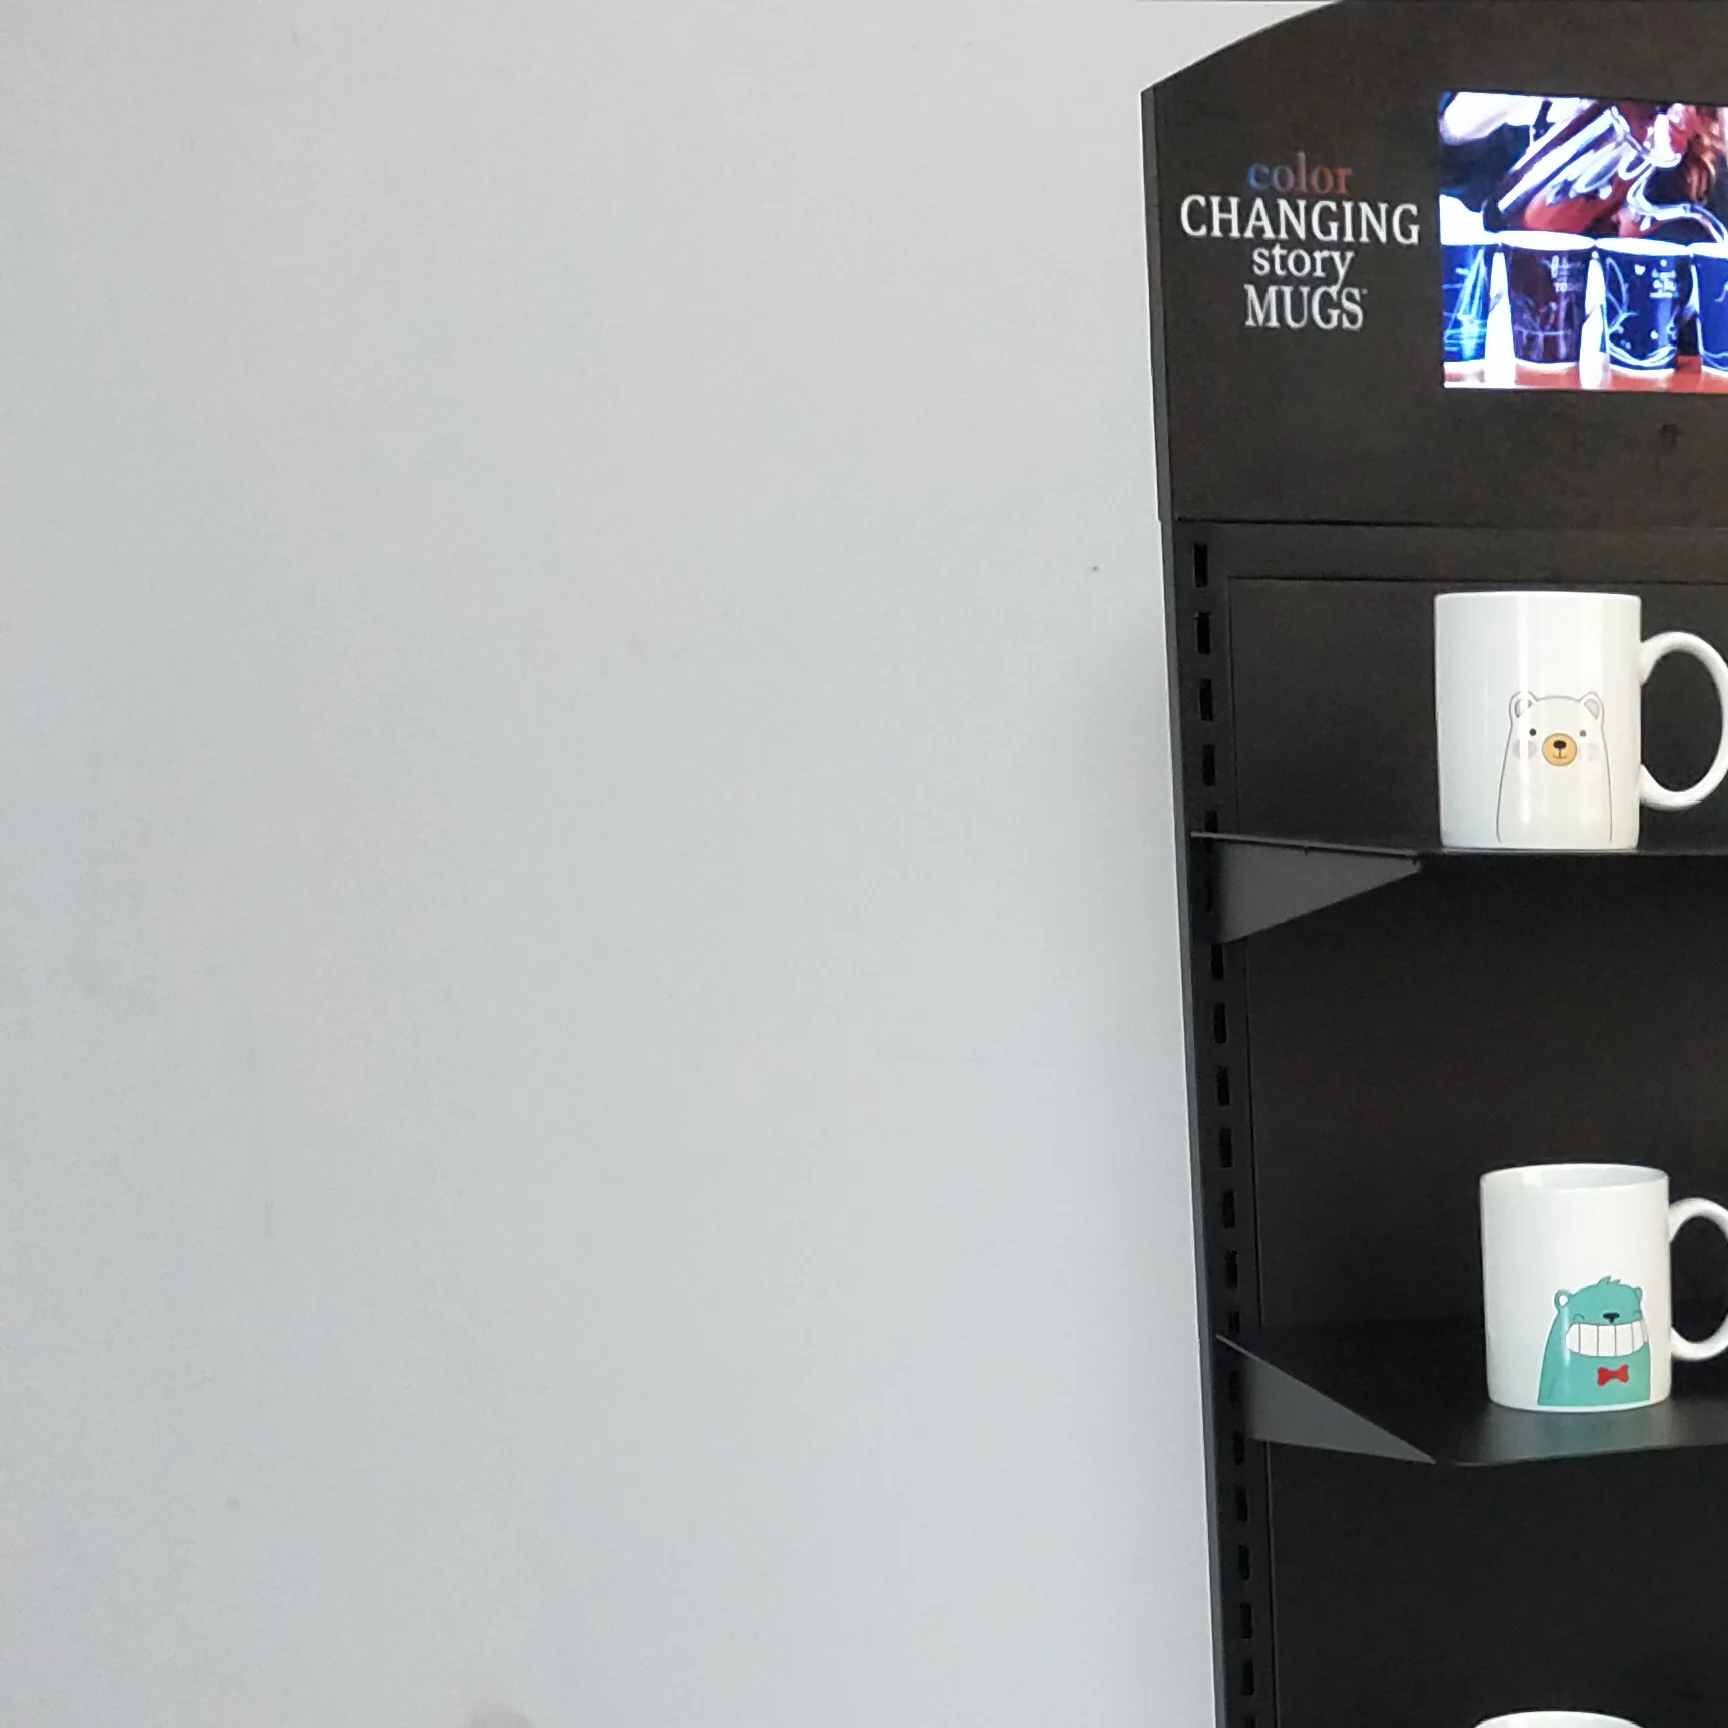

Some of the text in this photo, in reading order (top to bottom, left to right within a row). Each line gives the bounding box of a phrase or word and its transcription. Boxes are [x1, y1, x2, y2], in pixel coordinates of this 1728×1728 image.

[1246, 151, 1353, 195] color
[1180, 193, 1421, 246] CHANGING
[1252, 243, 1356, 289] story
